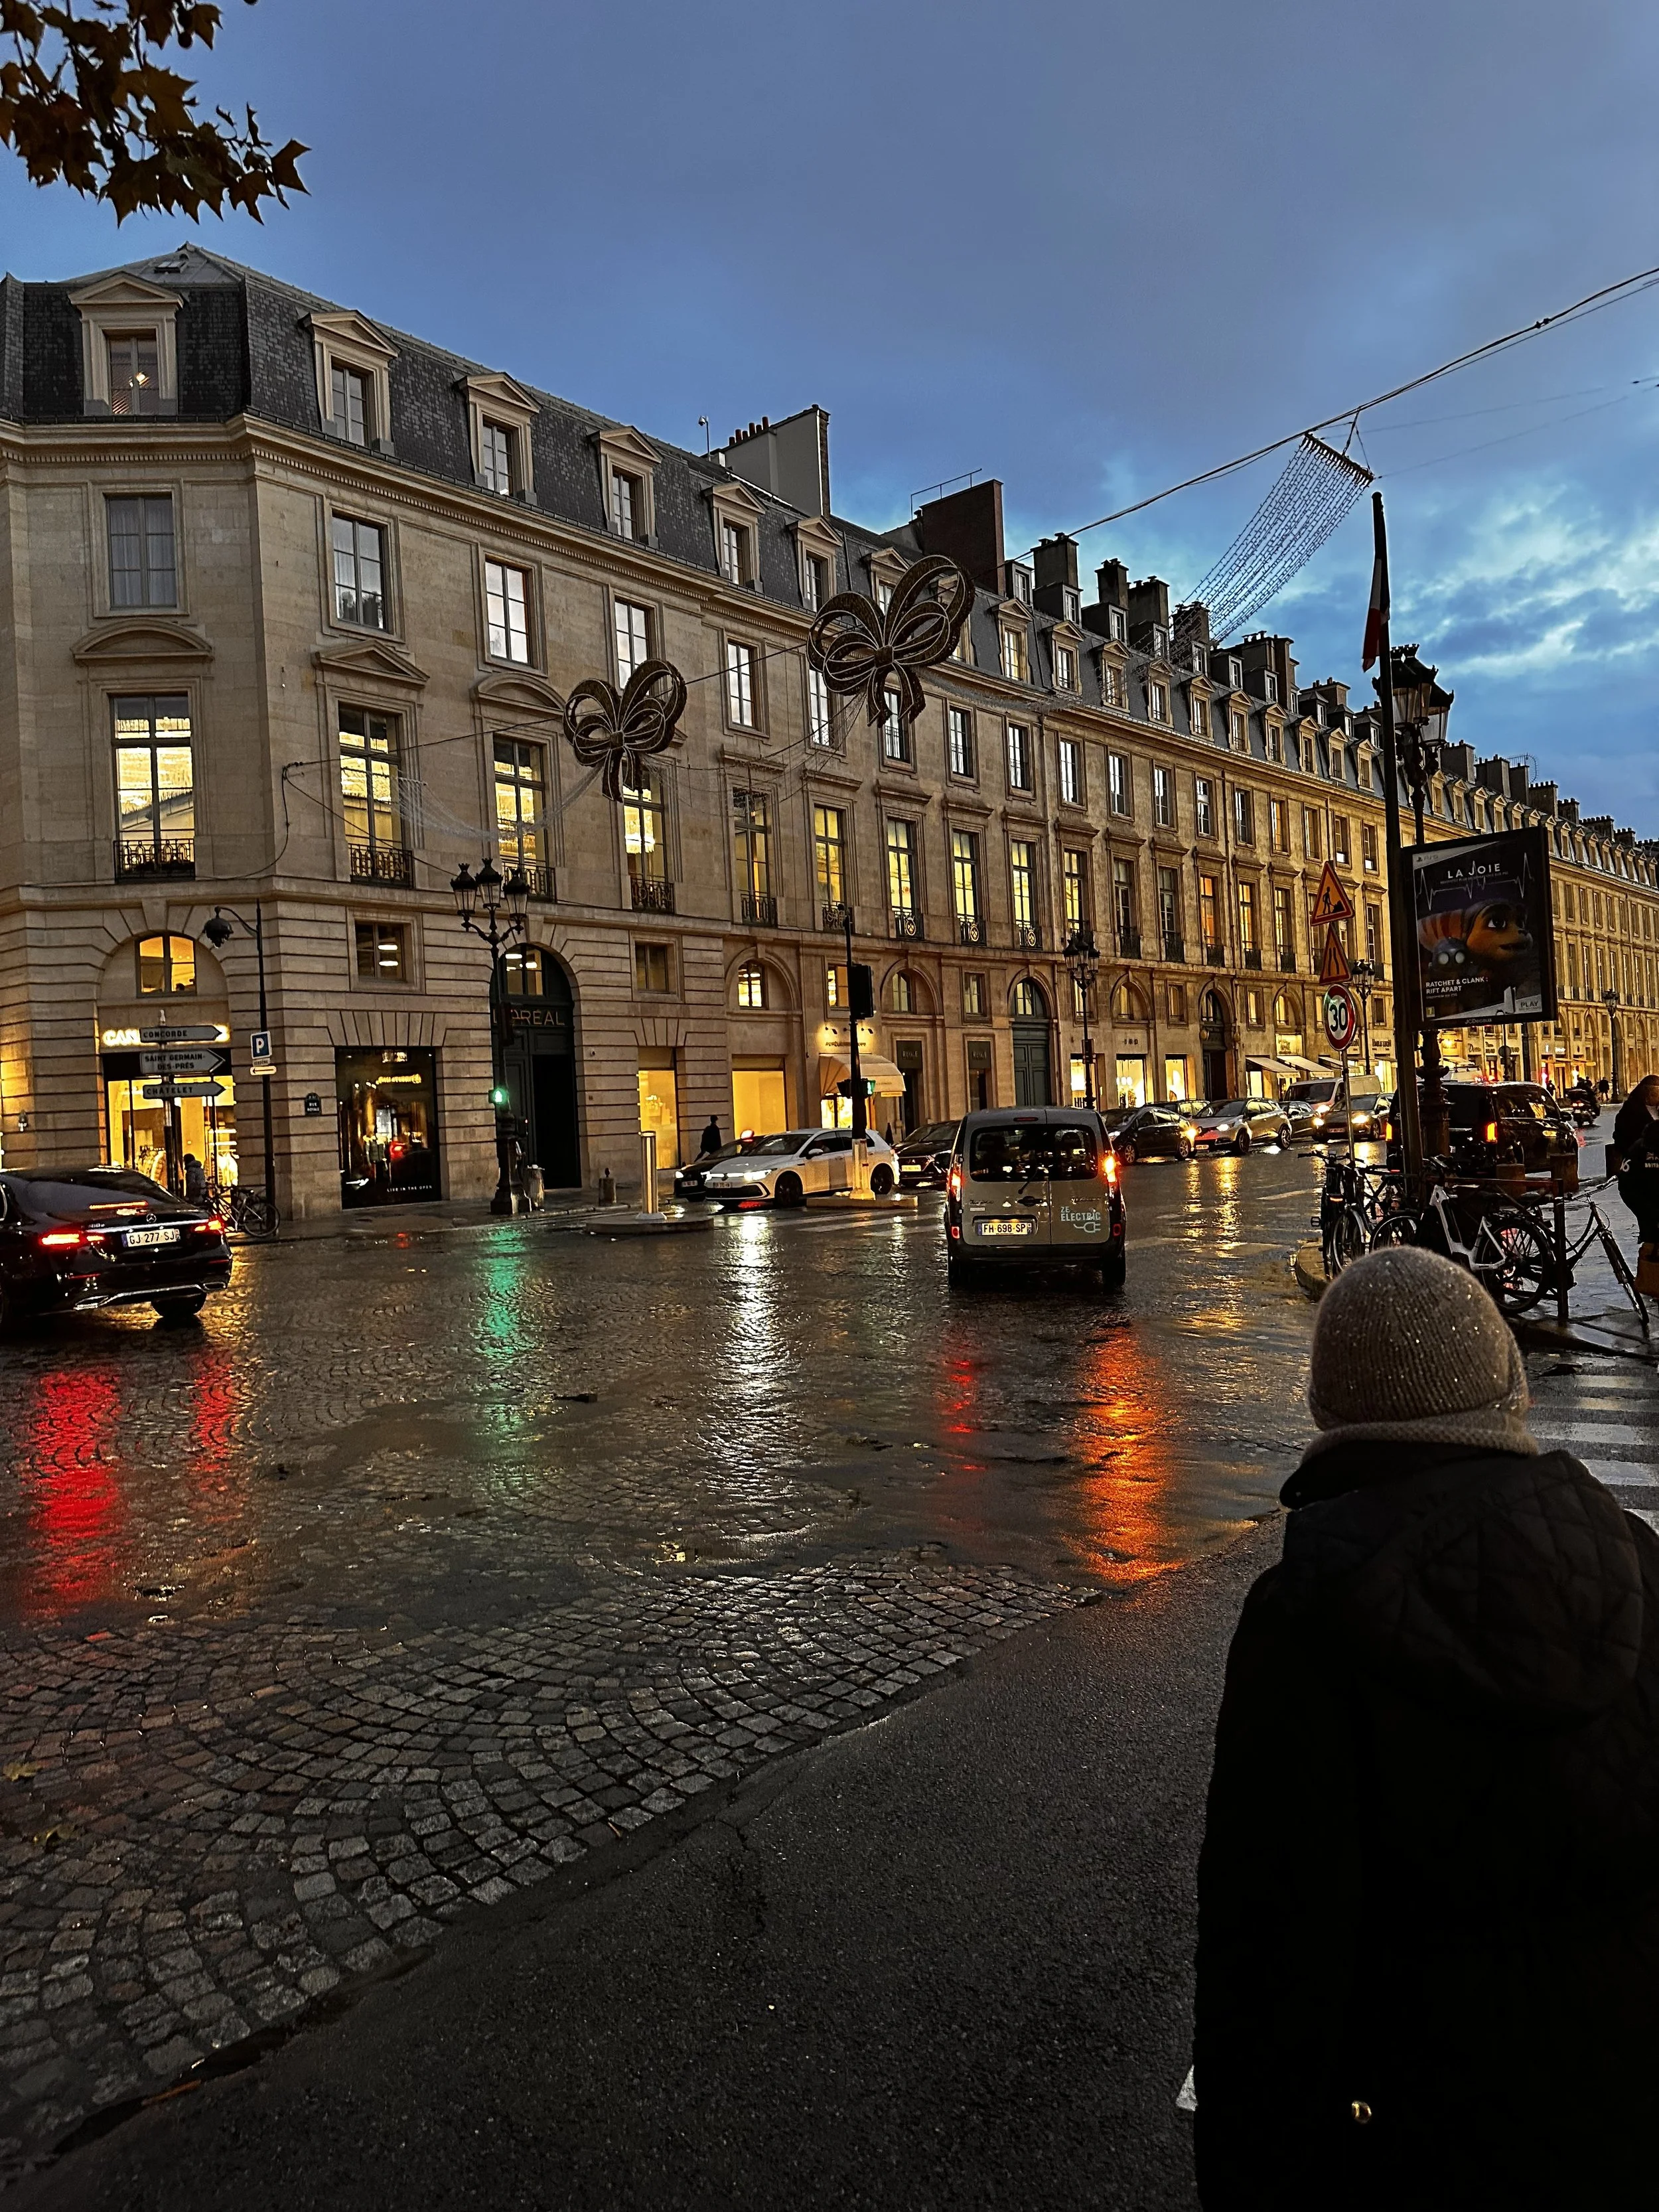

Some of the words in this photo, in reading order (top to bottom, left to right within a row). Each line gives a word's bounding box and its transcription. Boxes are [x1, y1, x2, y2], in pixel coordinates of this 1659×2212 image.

[1447, 869, 1463, 879] LA
[1469, 861, 1500, 876] JOIE
[492, 1009, 565, 1025] LRÉAL
[1329, 1002, 1348, 1033] 30
[255, 1037, 265, 1054] P
[147, 1086, 192, 1095] CHÂTELET
[1620, 1158, 1631, 1172] 16
[1060, 1212, 1101, 1222] ELECTRIC
